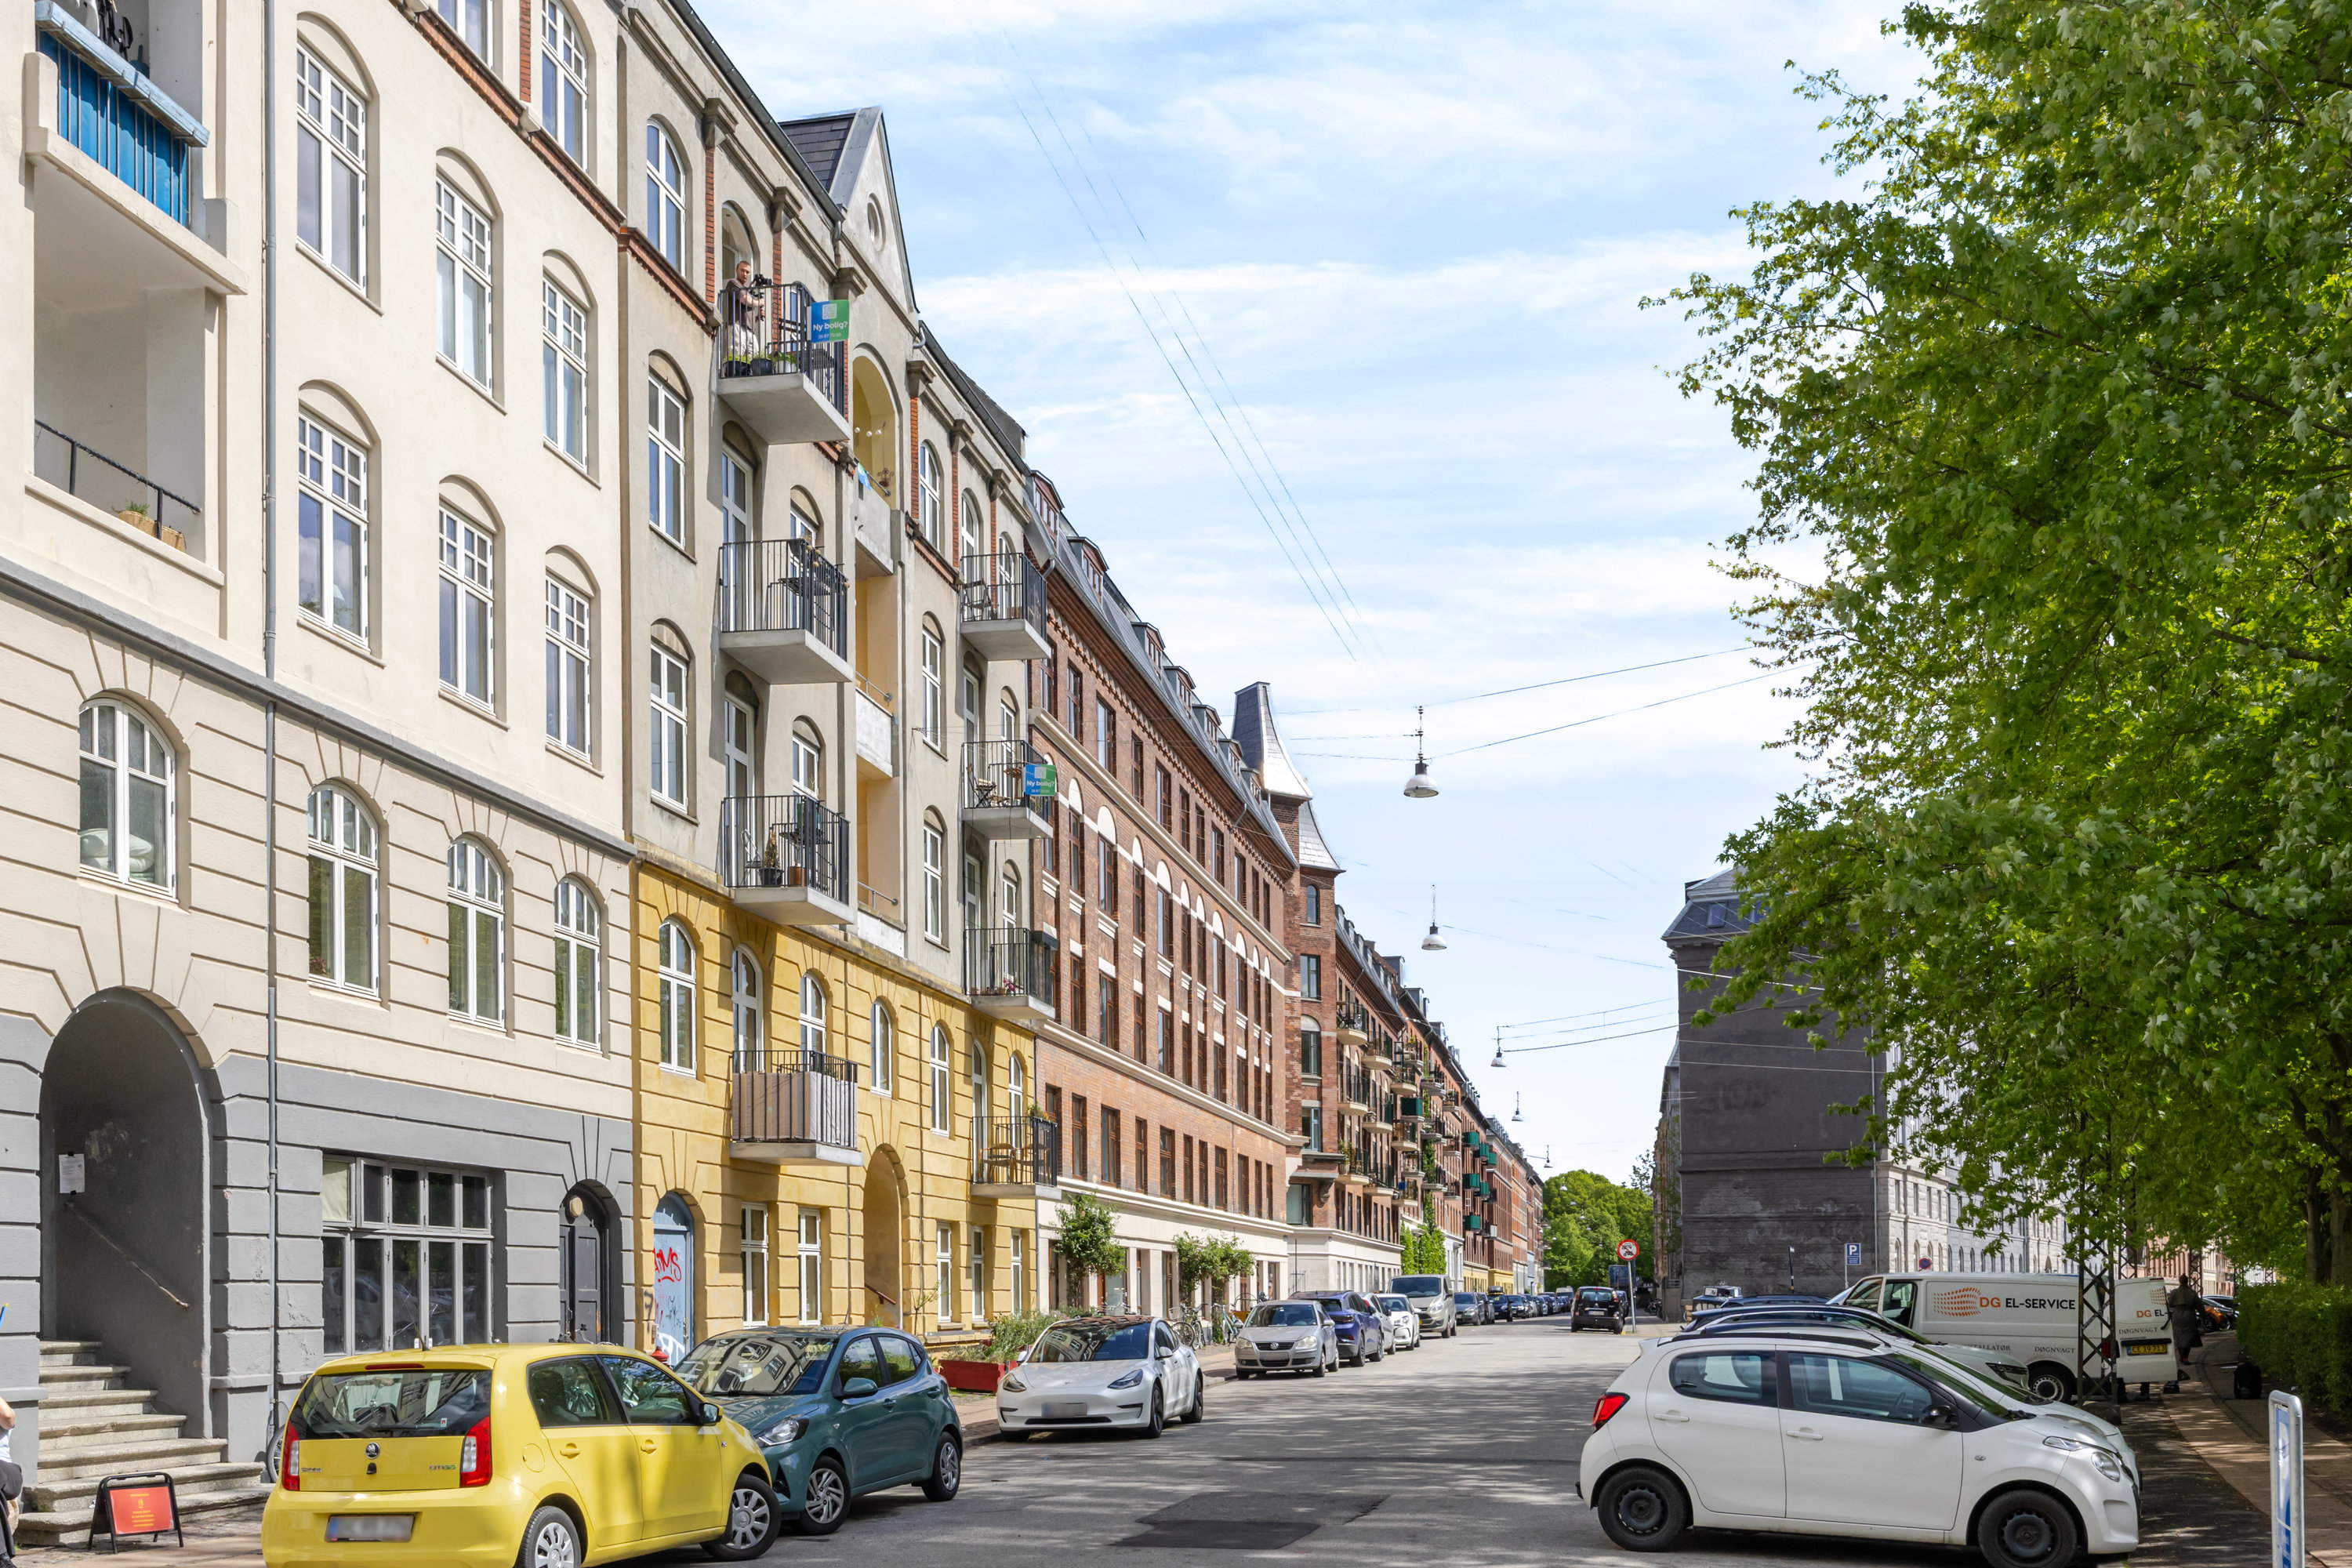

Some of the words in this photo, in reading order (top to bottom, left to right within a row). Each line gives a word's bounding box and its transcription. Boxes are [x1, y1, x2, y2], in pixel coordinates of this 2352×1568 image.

[824, 321, 848, 329] bolig?
[1849, 1244, 1857, 1255] P
[1980, 1297, 2001, 1308] DG
[2005, 1298, 2076, 1310] EL-SERVICE
